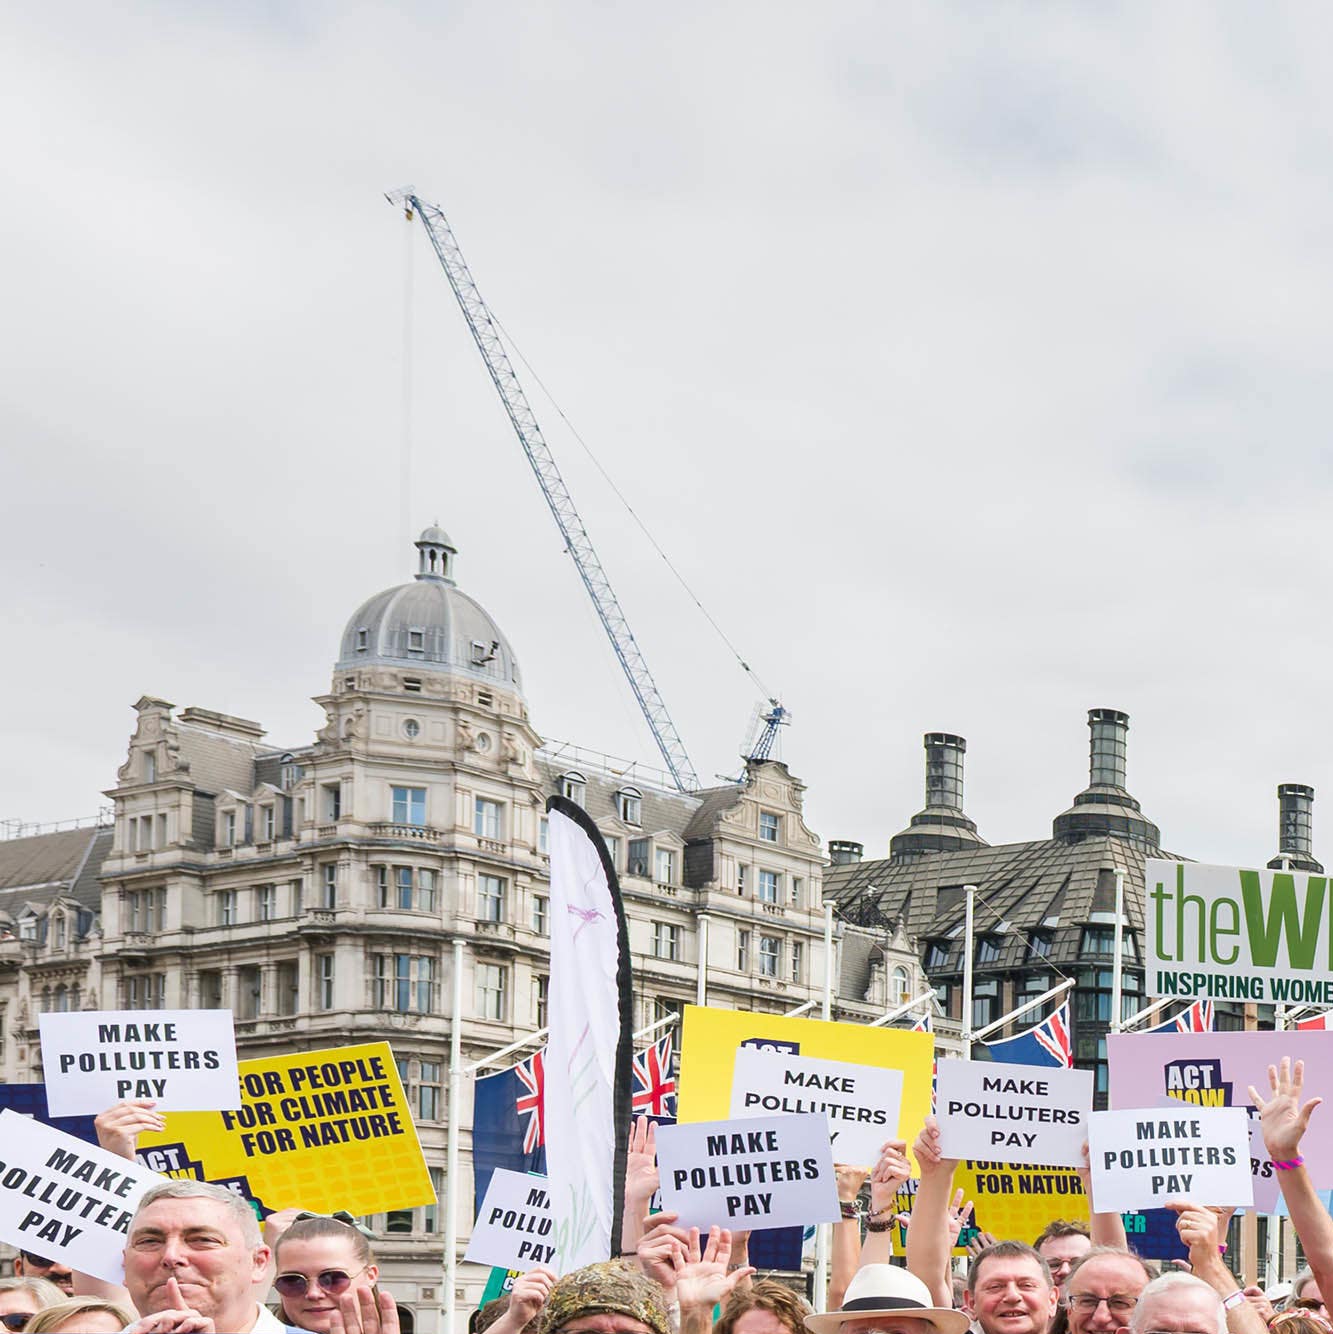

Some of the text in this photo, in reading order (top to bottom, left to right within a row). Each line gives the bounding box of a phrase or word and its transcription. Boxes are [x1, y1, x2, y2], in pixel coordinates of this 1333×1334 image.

[1157, 971, 1263, 999] INSPIRING
[99, 1023, 177, 1043] MAKE
[59, 1050, 220, 1073] POLLUTERS
[288, 1057, 387, 1091] PEOPLE
[784, 1070, 855, 1093] MAKE
[1168, 1065, 1214, 1089] ACT
[117, 1079, 167, 1098] PAY
[983, 1077, 1049, 1096] MAKE
[221, 1084, 396, 1131] FOR CLIMATE
[745, 1093, 887, 1124] POLLUTERS
[948, 1102, 1080, 1125] POLLUTERS
[241, 1112, 405, 1157] FOR NATURE
[991, 1131, 1038, 1148] PAY
[1136, 1120, 1201, 1140] MAKE
[707, 1131, 779, 1157] MAKE
[1104, 1147, 1237, 1170] POLLUTERS
[46, 1148, 138, 1198] MAKE
[674, 1158, 819, 1191] POLLUTERS
[976, 1174, 1086, 1194] FOR NATUR
[1152, 1174, 1193, 1195] PAY
[727, 1193, 772, 1217] PAY
[18, 1210, 83, 1248] PAY
[518, 1241, 556, 1264] PAY
